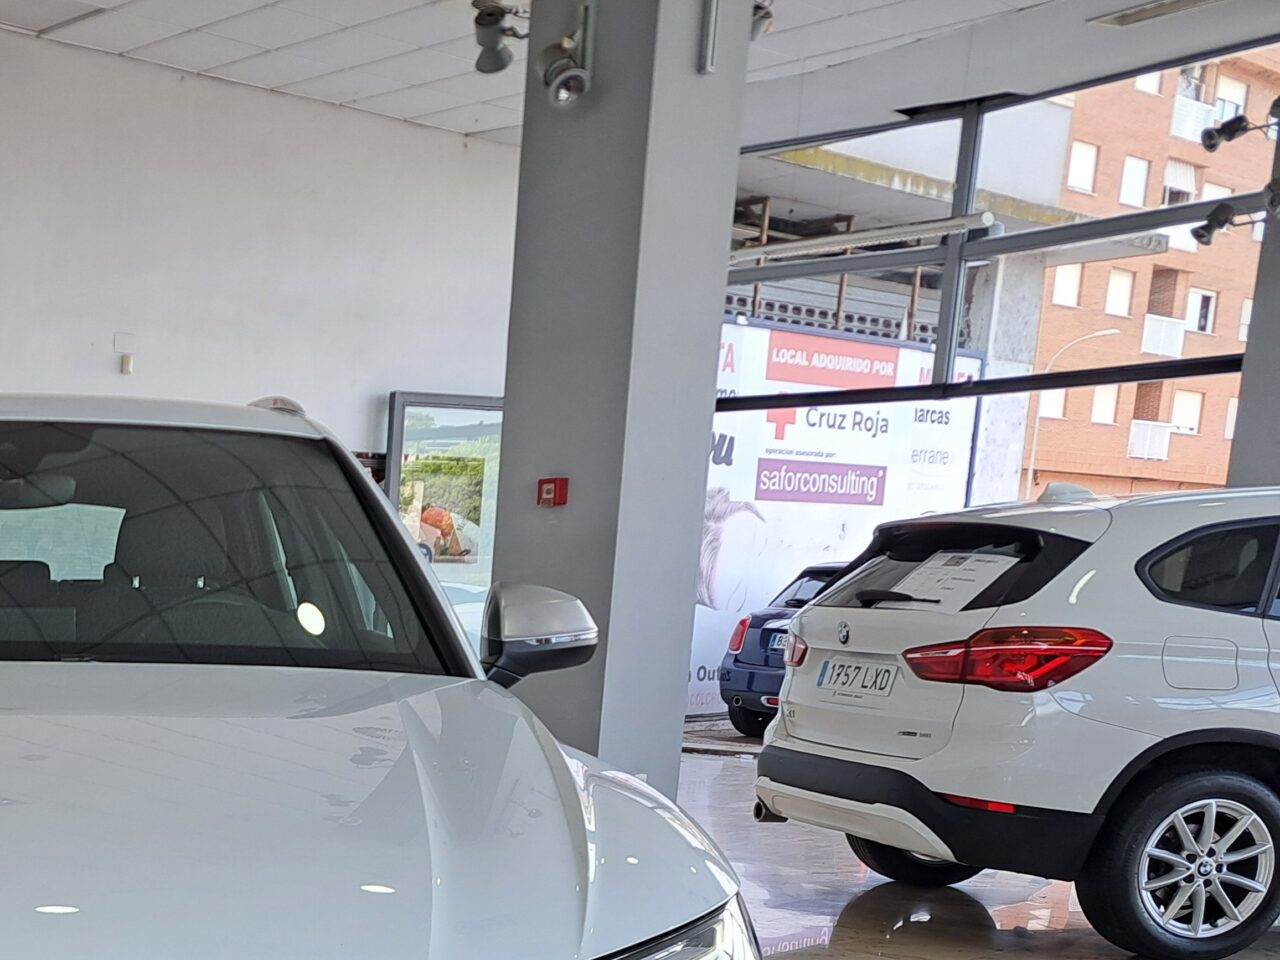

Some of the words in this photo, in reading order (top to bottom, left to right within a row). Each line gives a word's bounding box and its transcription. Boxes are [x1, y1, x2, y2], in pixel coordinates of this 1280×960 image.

[772, 347, 810, 367] LOCAL
[810, 352, 872, 375] ADQUIRIDO
[871, 359, 895, 377] POR
[805, 407, 848, 431] Cruz
[851, 410, 890, 439] Roja
[759, 464, 878, 503] saforconsulting
[828, 663, 862, 688] 1757
[861, 666, 891, 691] LXD
